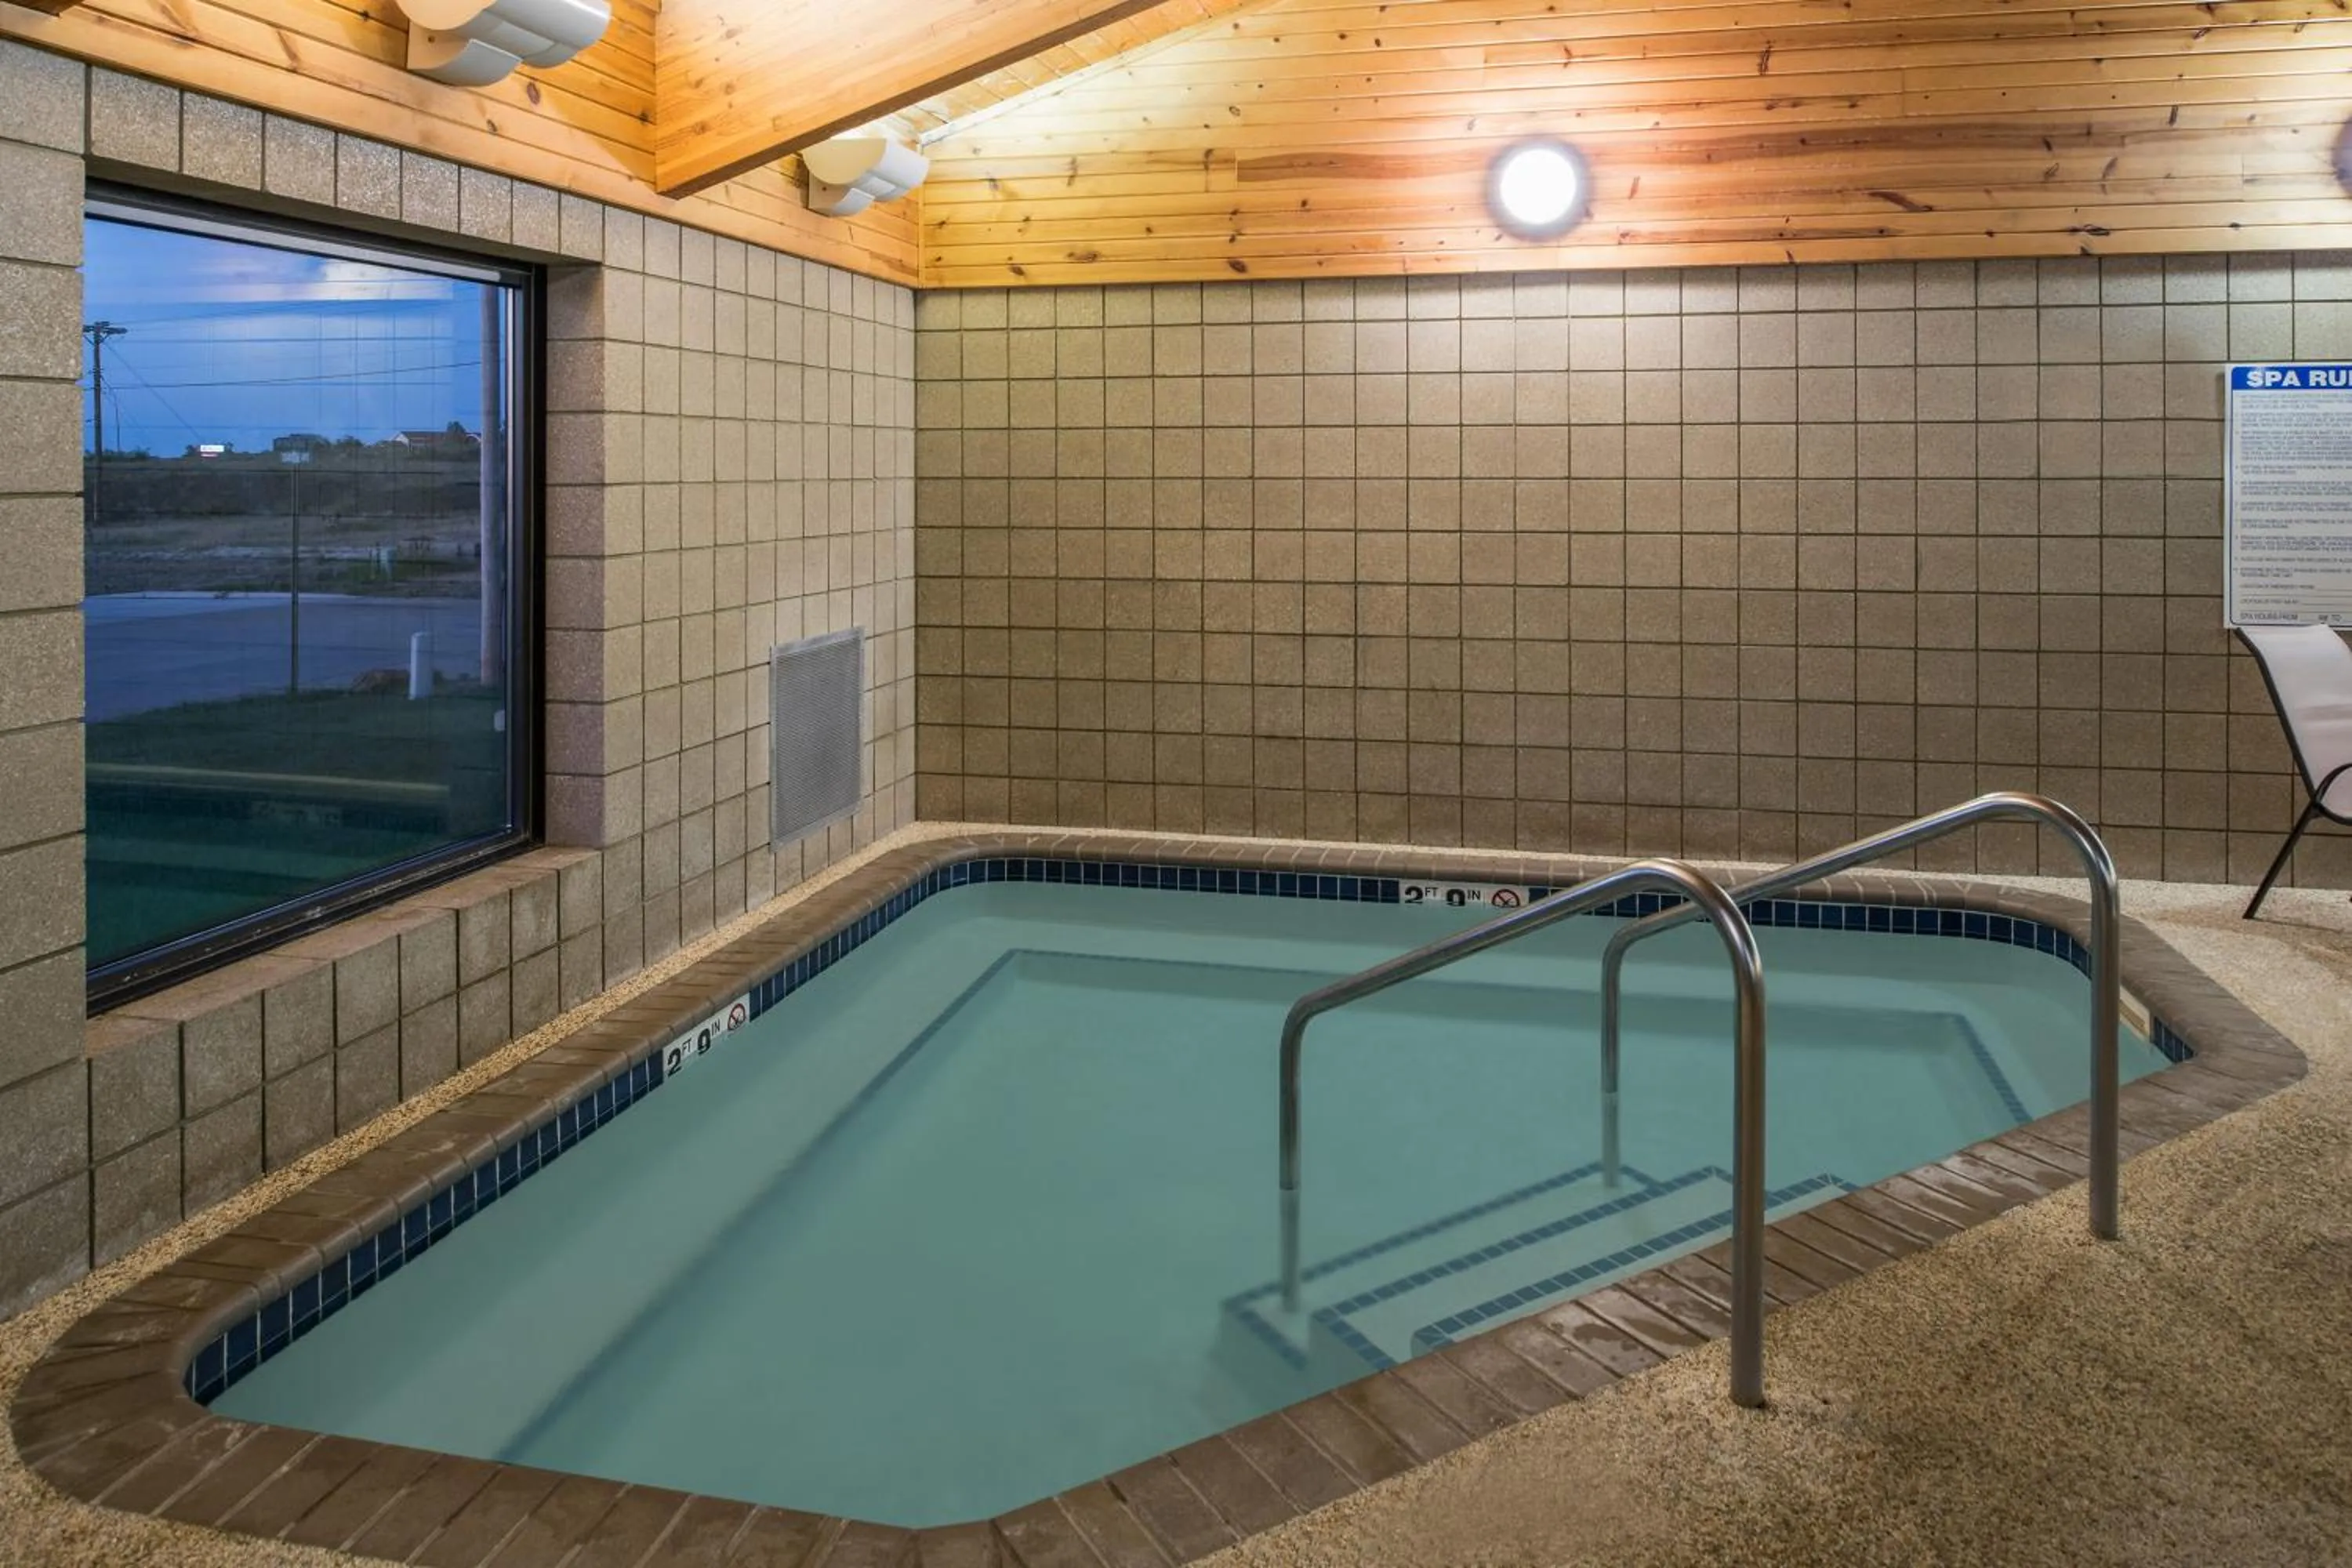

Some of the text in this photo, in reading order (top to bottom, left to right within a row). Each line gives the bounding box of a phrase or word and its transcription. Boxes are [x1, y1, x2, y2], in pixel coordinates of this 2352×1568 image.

[2247, 369, 2352, 387] SPA RU
[1404, 886, 1423, 904] 2
[1425, 887, 1438, 897] FT
[1467, 889, 1481, 900] IN
[667, 1047, 682, 1076] 2
[681, 1038, 691, 1055] FT
[711, 1018, 720, 1036] IN
